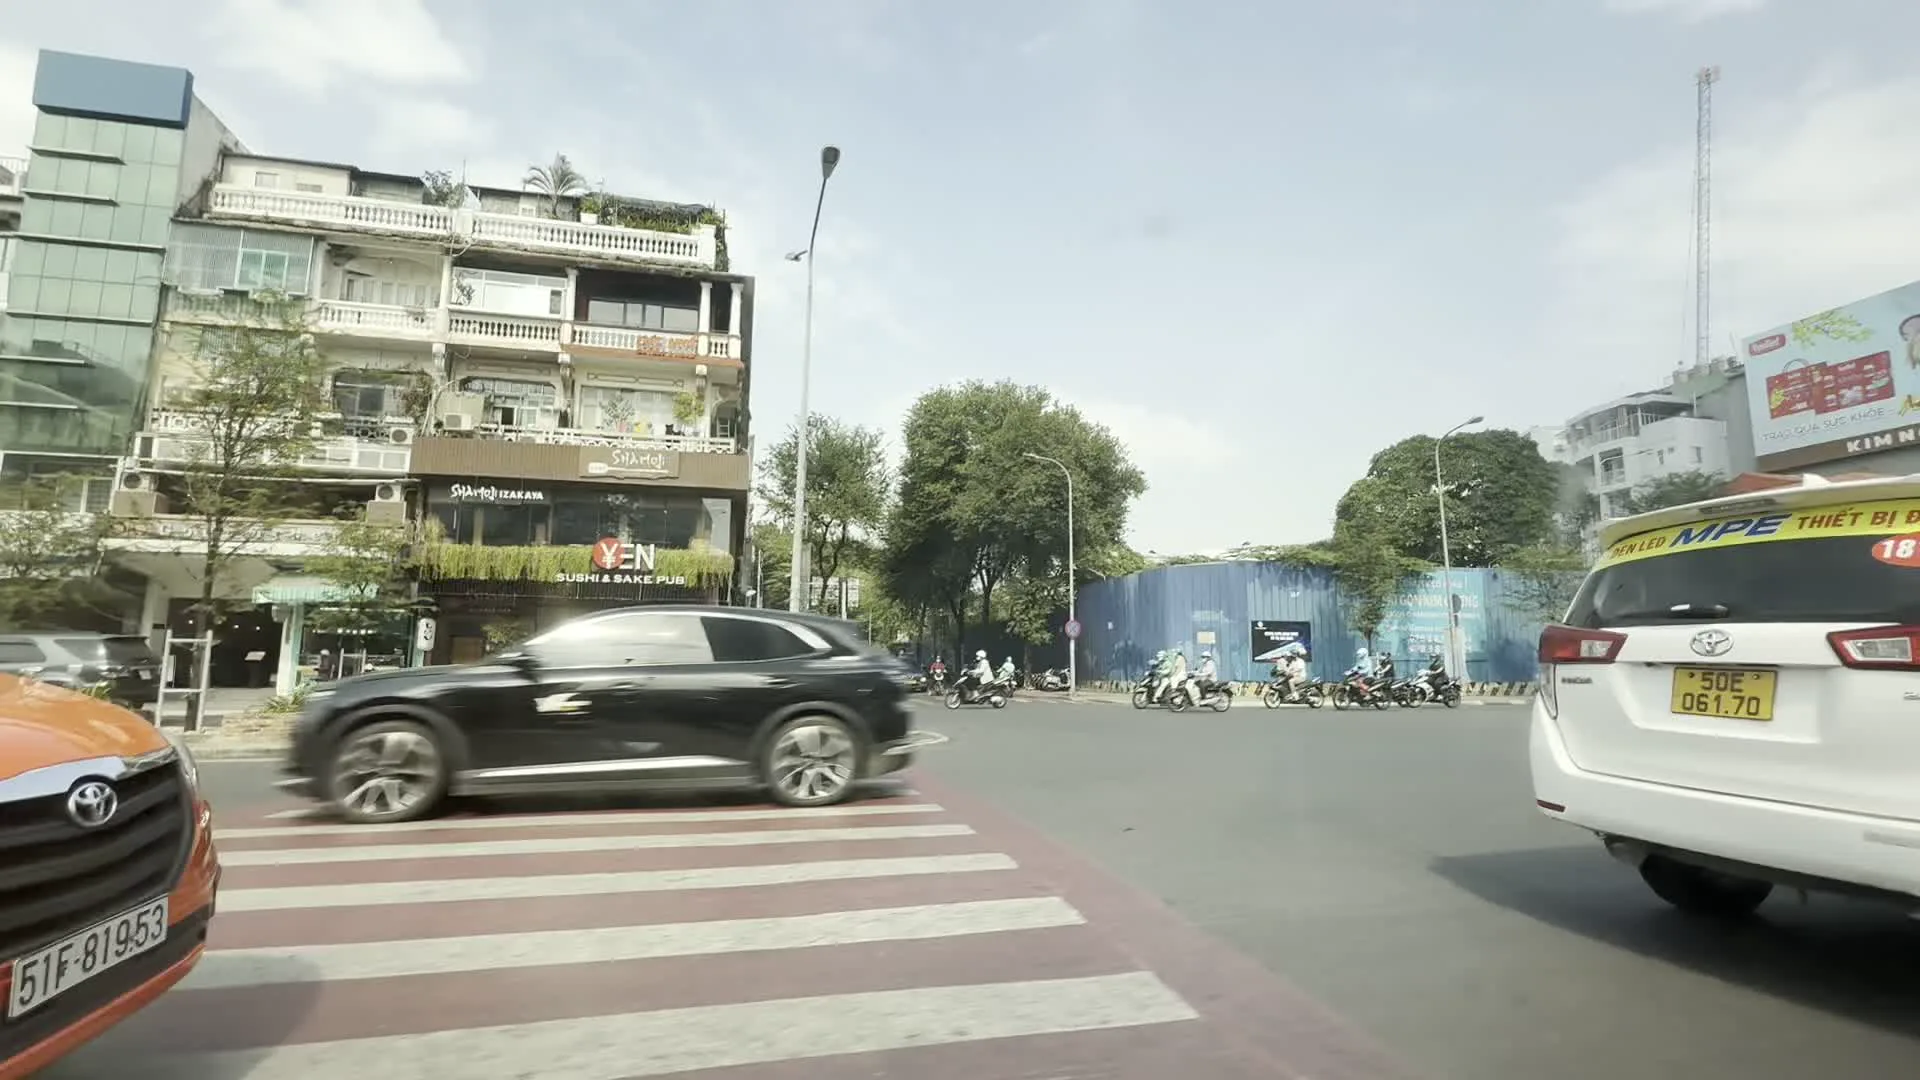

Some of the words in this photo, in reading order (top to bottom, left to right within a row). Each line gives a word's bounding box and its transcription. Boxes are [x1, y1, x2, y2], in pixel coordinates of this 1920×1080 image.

[1847, 433, 1892, 452] KIM
[1898, 428, 1920, 443] N
[499, 490, 544, 500] IZAKAYA
[1639, 536, 1667, 551] LED
[1669, 513, 1792, 548] MPE
[1797, 507, 1864, 530] THIẾT
[1870, 510, 1898, 528] BỊ
[1882, 539, 1920, 559] 18
[556, 573, 600, 583] SUSHI
[601, 574, 611, 583] &
[613, 574, 653, 584] SAKE
[656, 575, 685, 585] PUB
[1700, 671, 1744, 693] 50E
[1681, 693, 1761, 716] 061.70
[19, 903, 164, 1006] 51F-819.53
